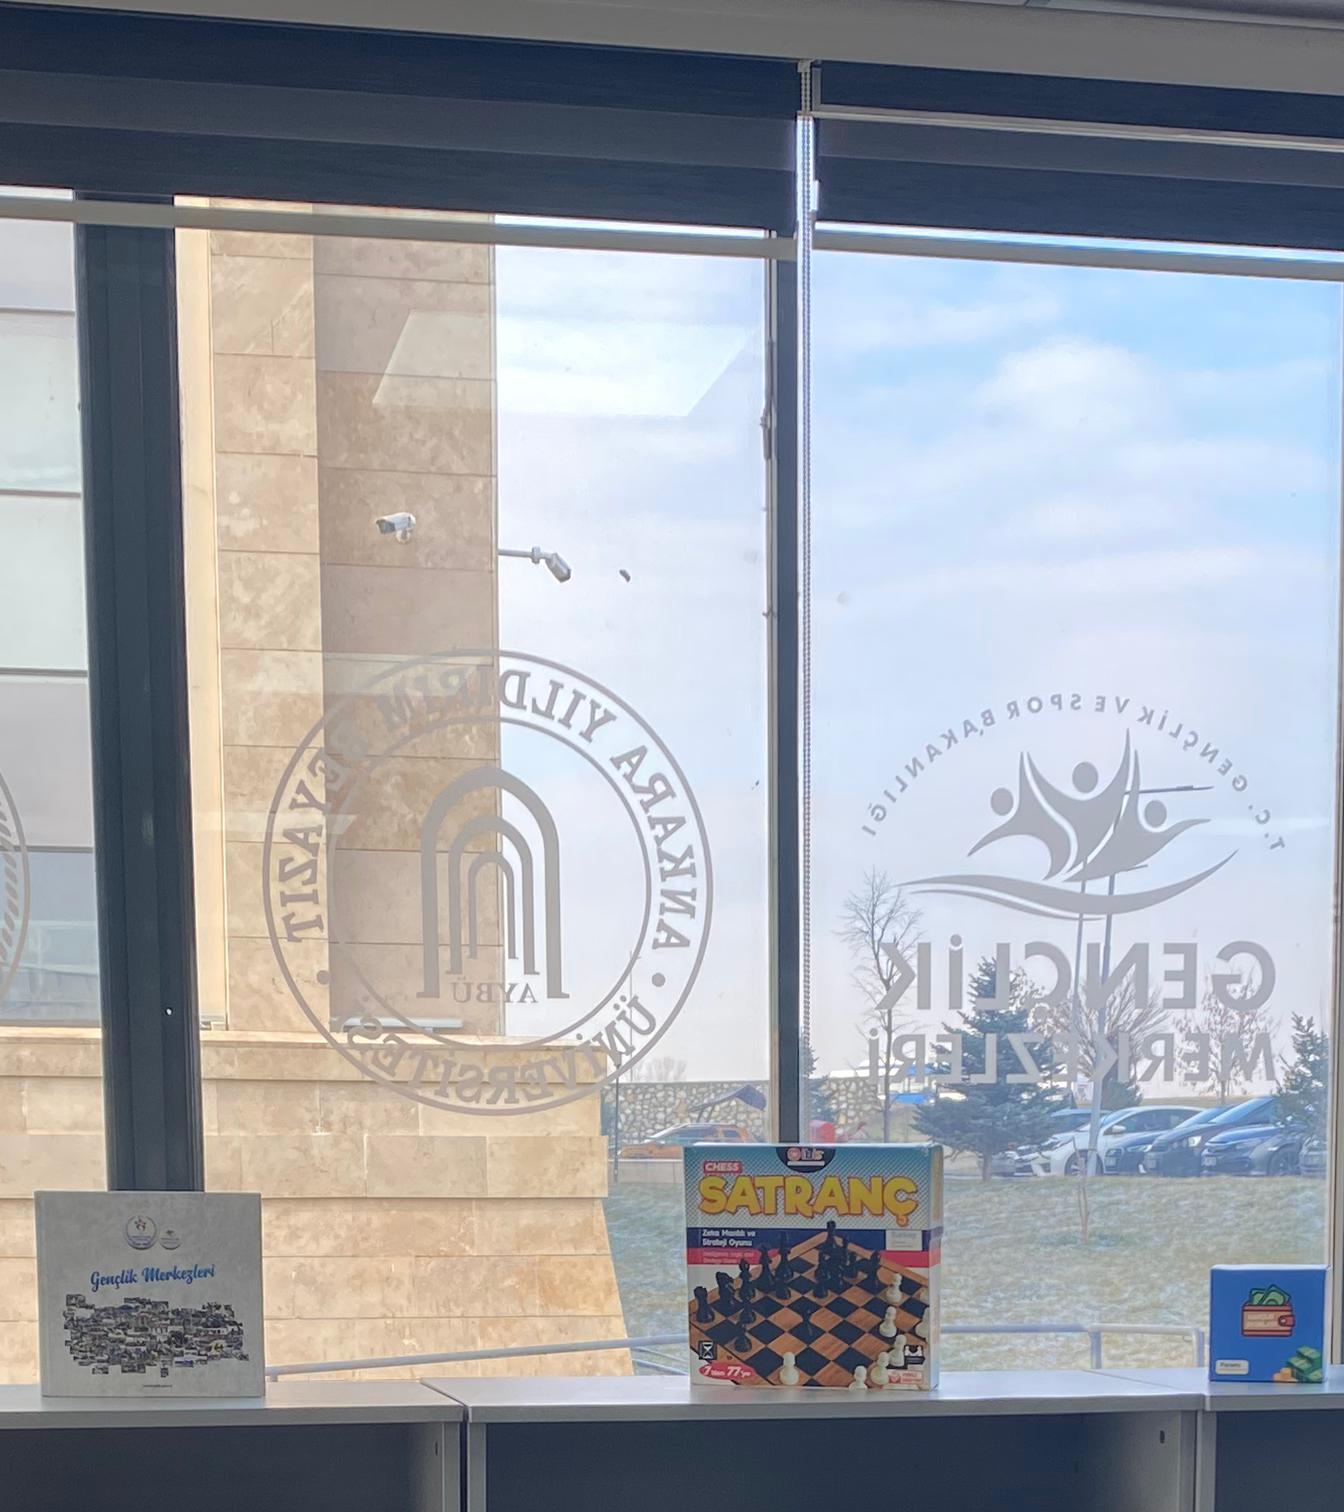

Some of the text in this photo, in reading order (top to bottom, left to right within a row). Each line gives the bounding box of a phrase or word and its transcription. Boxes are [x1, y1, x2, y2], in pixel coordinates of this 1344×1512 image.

[705, 1162, 740, 1172] CHESS
[699, 1174, 919, 1227] SATRANÇ
[90, 1264, 216, 1293] Gençlik Merkezleri
